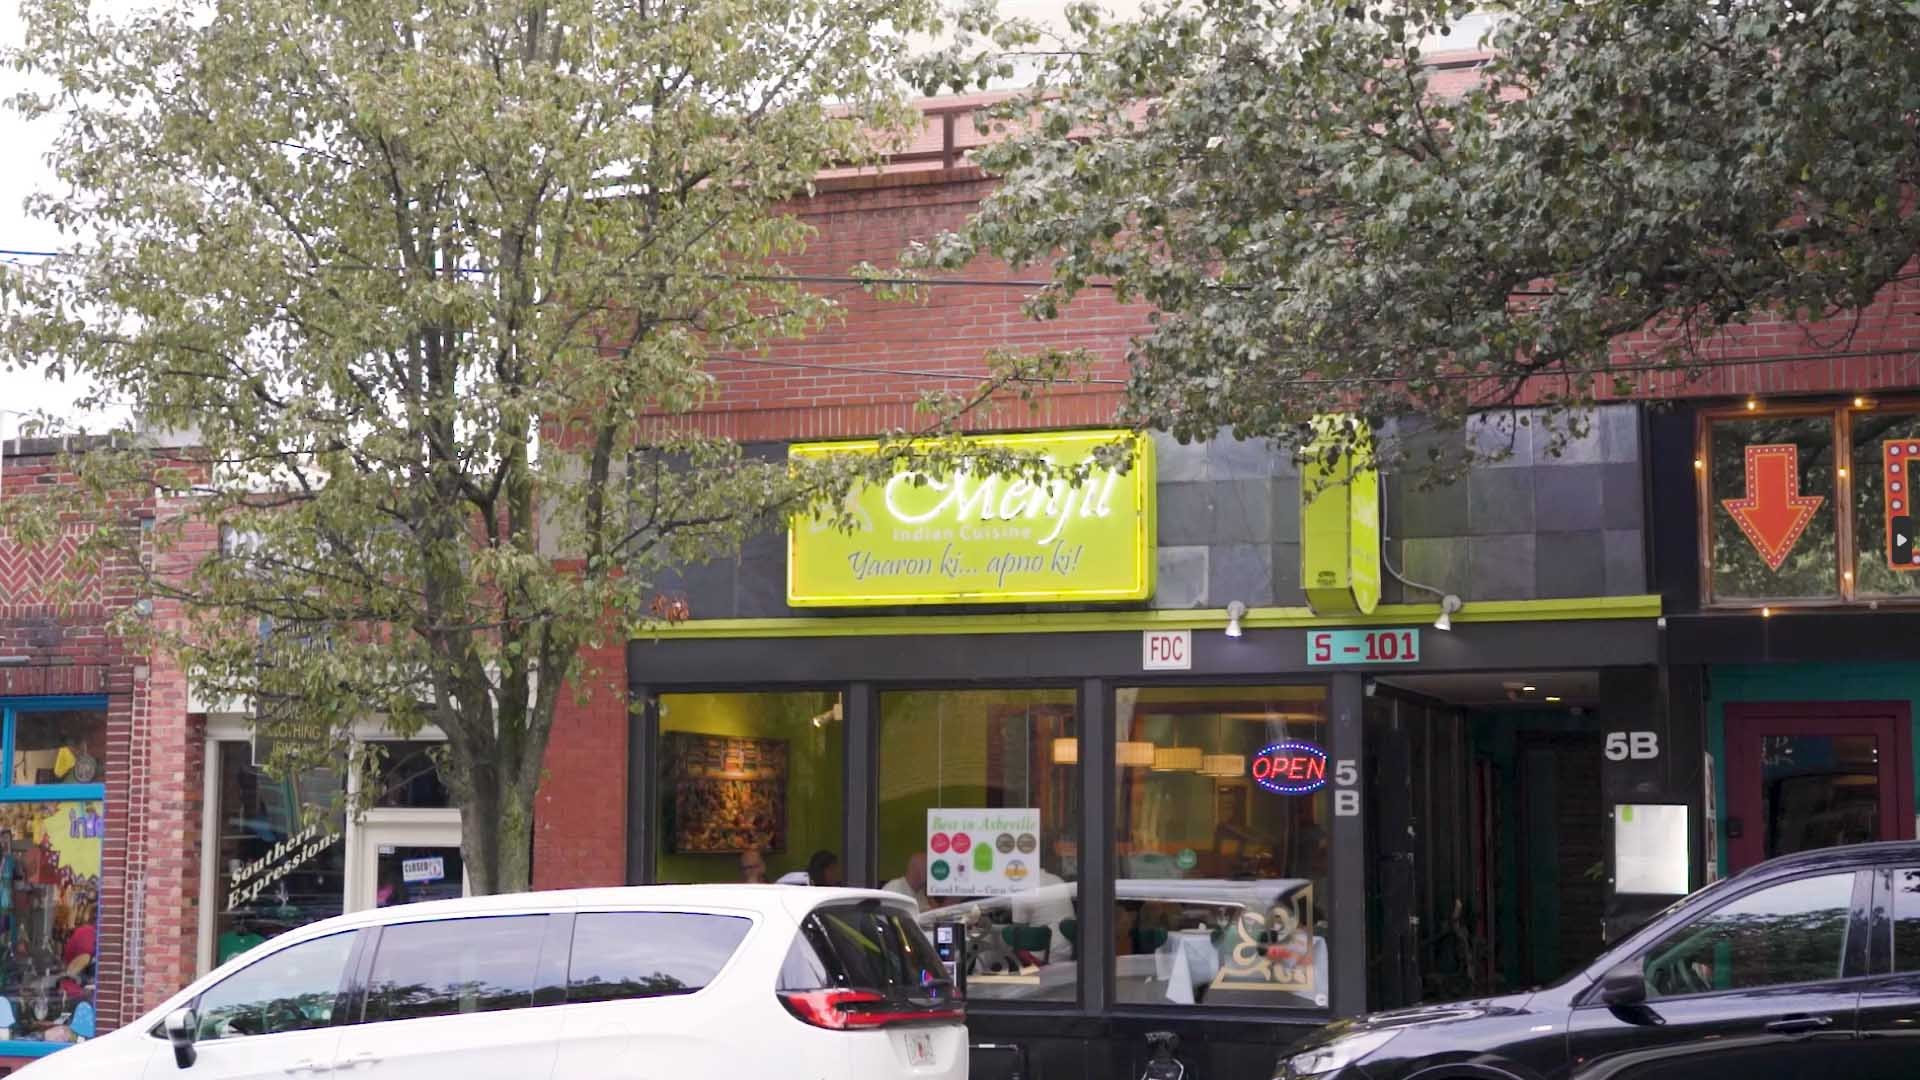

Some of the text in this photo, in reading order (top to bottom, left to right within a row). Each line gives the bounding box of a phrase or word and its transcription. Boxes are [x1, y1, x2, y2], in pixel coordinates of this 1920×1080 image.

[892, 525, 1032, 542] Indian Cuisine
[848, 550, 932, 581] Yaaron
[986, 551, 1044, 589] apno
[1050, 539, 1083, 577] ki!
[1150, 635, 1184, 662] FDC
[262, 722, 321, 740] LOHING
[1604, 730, 1660, 761] 5B
[1252, 756, 1327, 780] OPEN
[230, 824, 317, 889] Southern
[225, 832, 341, 913] Expressions
